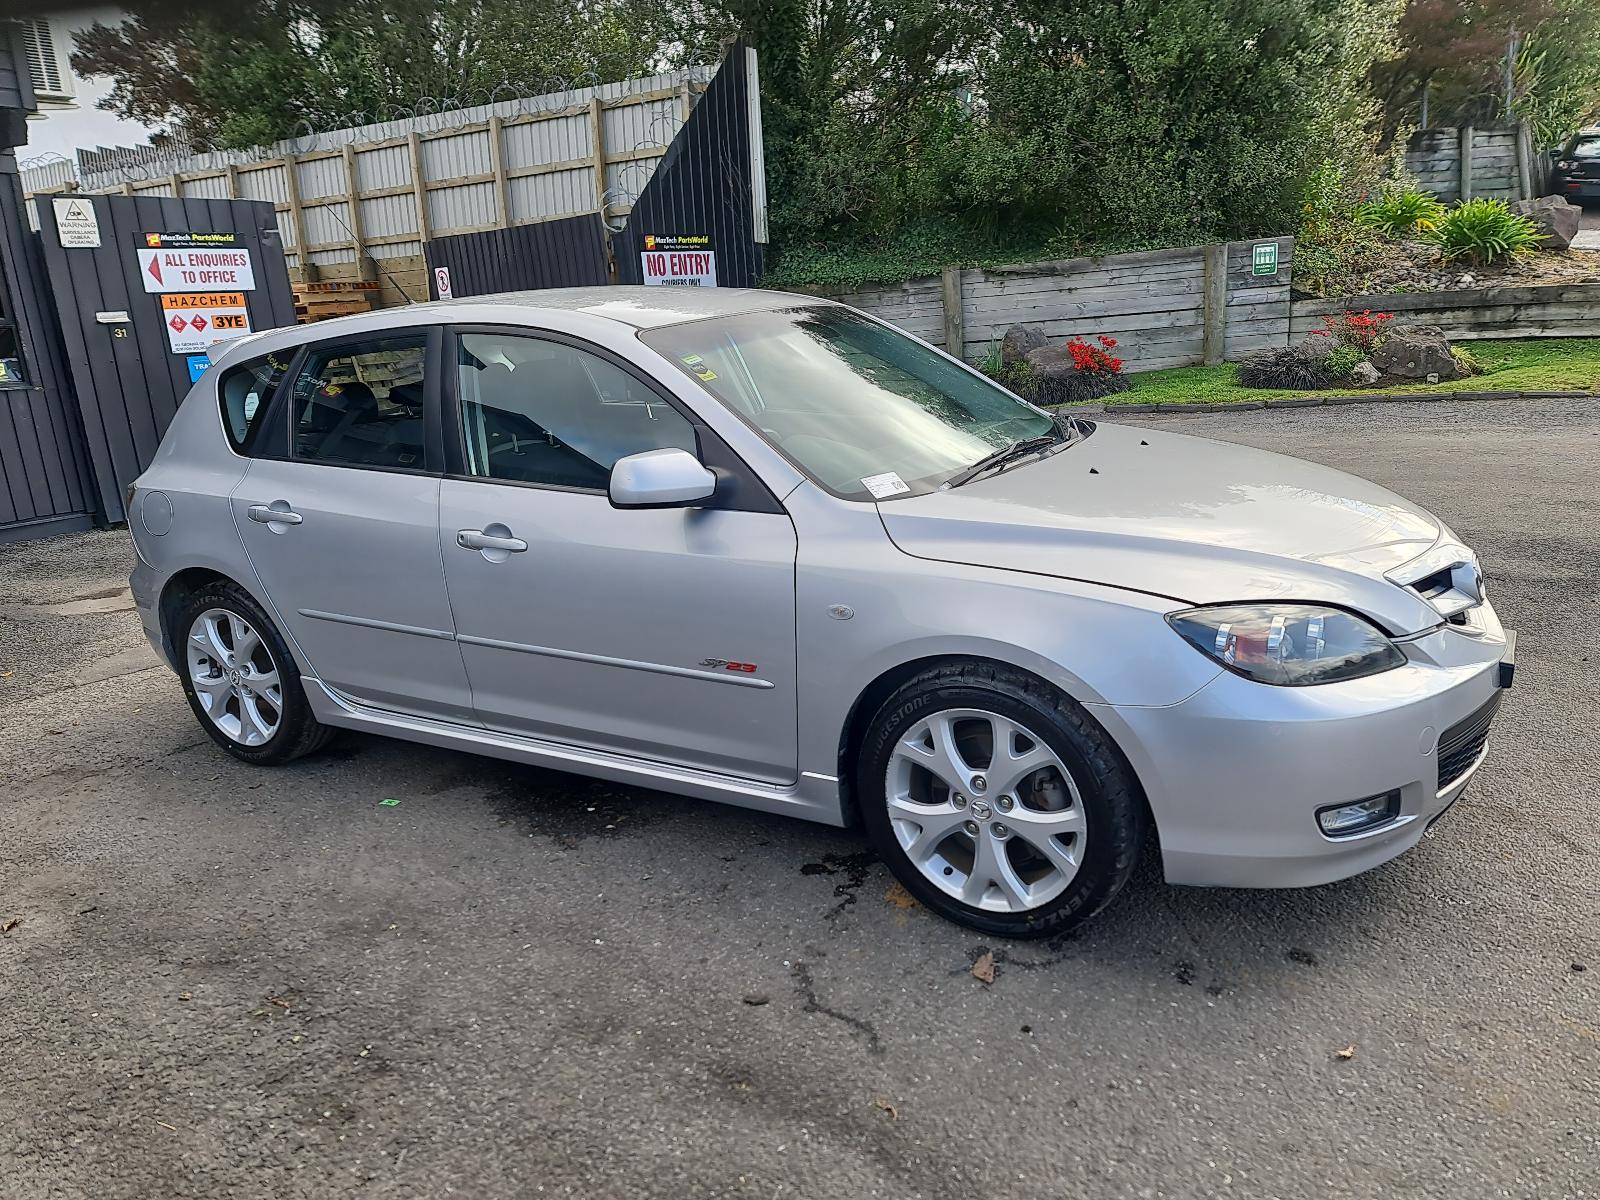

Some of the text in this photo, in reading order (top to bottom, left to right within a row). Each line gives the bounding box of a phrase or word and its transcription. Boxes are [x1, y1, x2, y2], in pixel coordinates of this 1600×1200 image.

[160, 233, 235, 242] MazTech PartsWorld
[655, 236, 709, 244] MazTech PartsWorld
[165, 253, 247, 267] ALL ENQUIRIES
[646, 253, 710, 277] NO ENTRY
[181, 270, 237, 283] TO OFFICE
[169, 295, 239, 307] HAZCHEM
[215, 315, 244, 327] 3YE
[114, 328, 128, 338] 31
